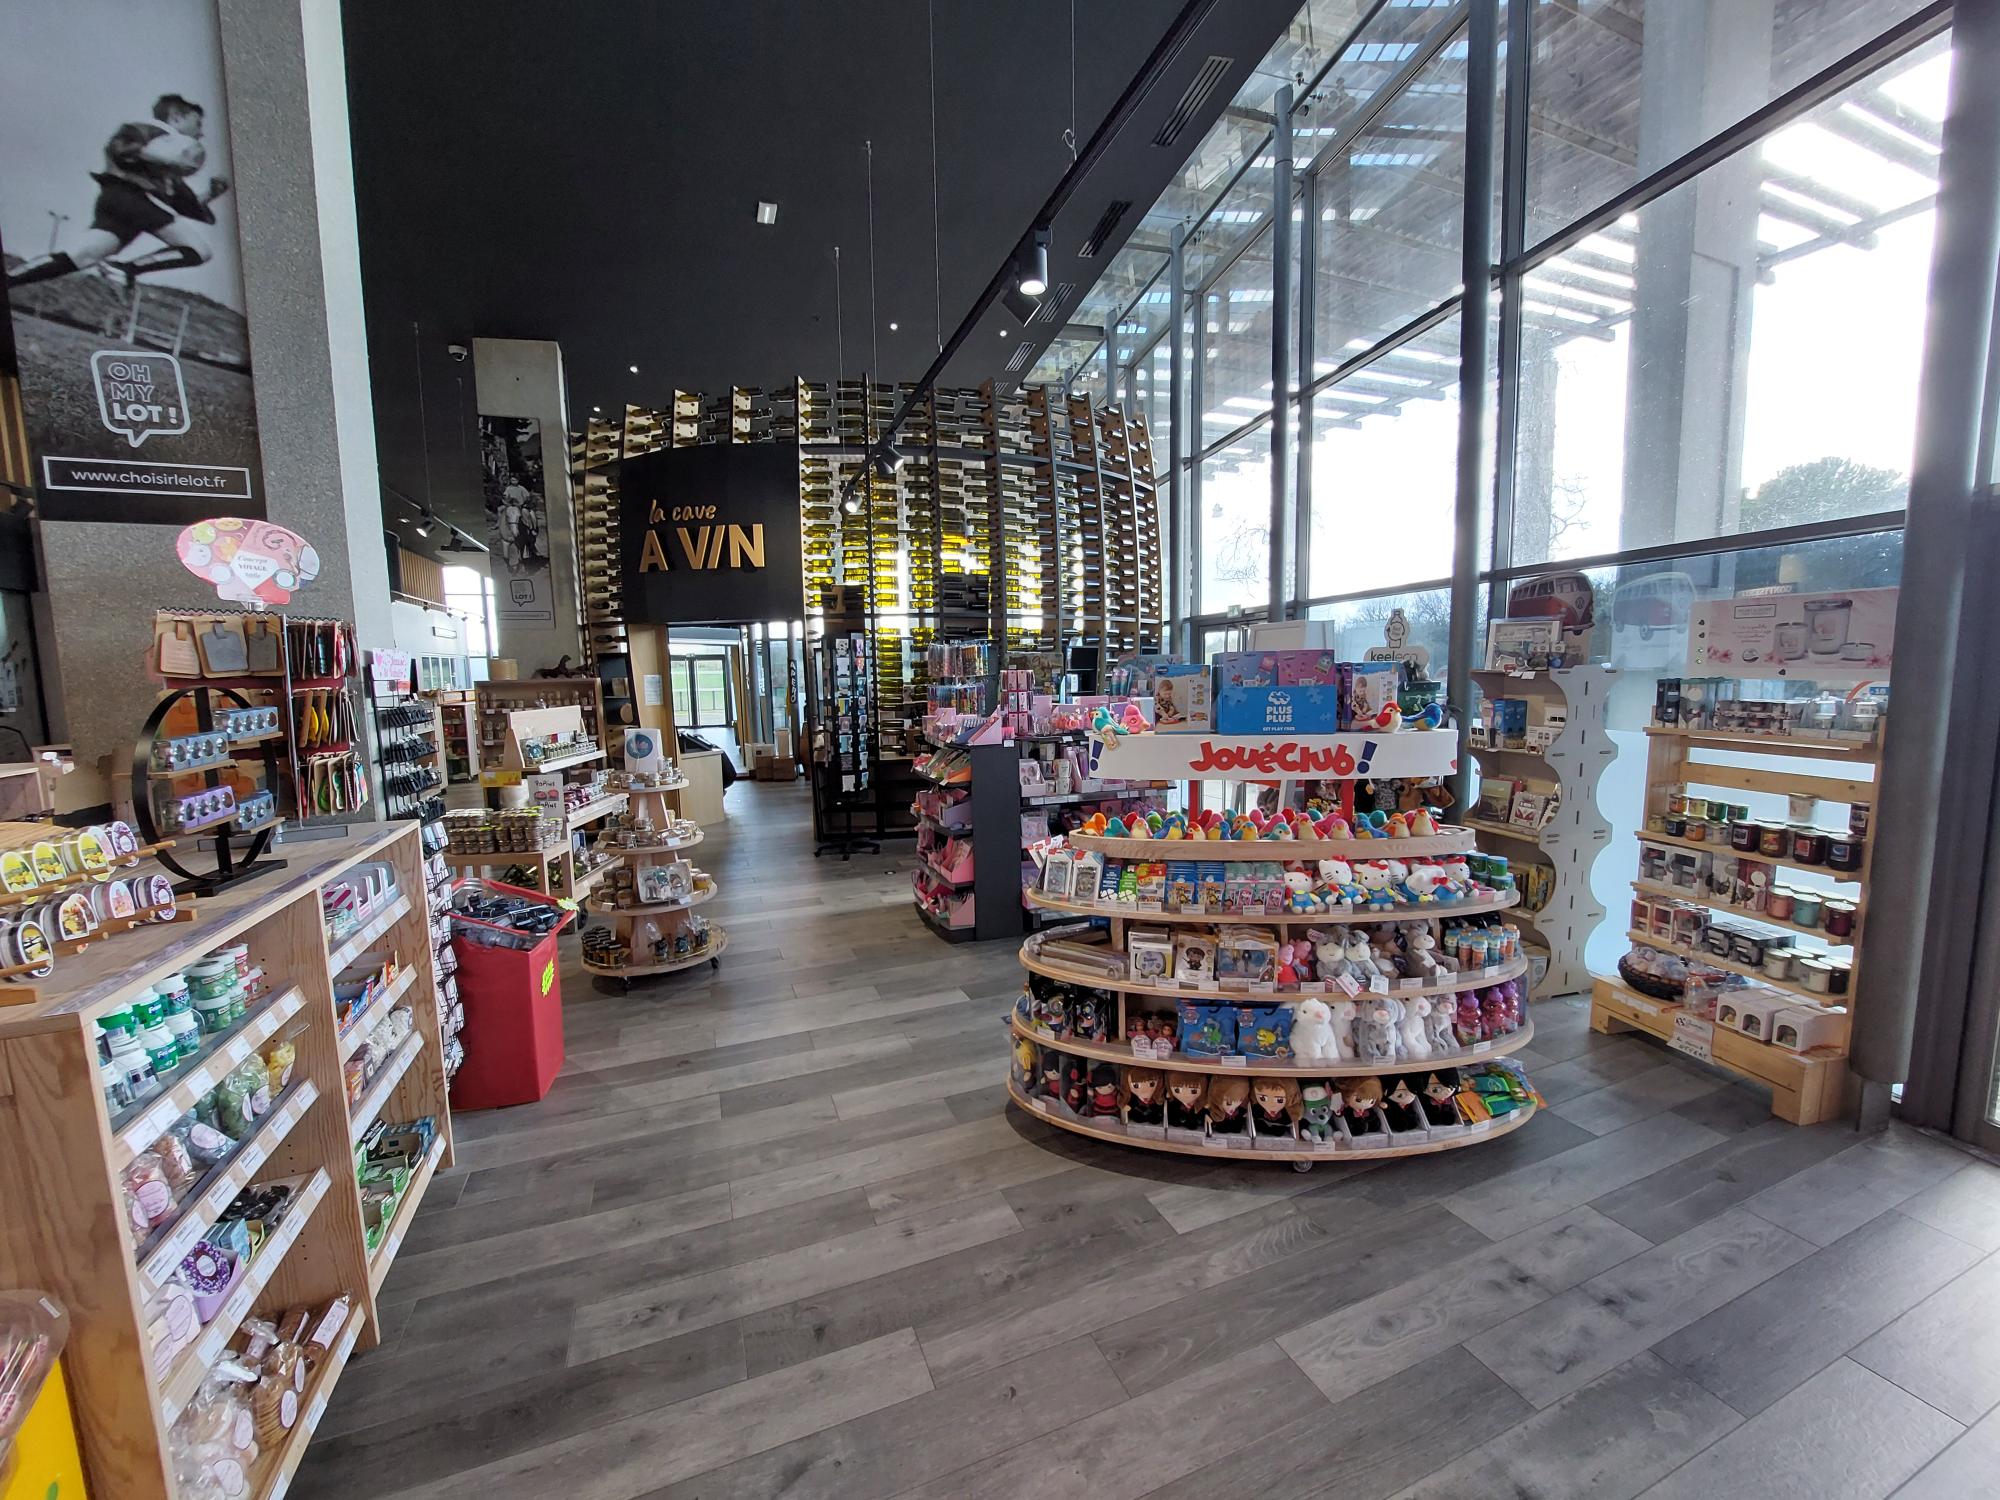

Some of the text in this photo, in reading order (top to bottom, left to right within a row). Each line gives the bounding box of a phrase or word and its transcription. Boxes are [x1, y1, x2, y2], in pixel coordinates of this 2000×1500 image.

[108, 362, 151, 383] OH
[110, 382, 155, 403] MY
[112, 402, 163, 423] LOT
[71, 470, 228, 488] www.choisirlelot.fr
[649, 499, 717, 524] la cave
[638, 523, 766, 573] A VIN
[1266, 706, 1293, 715] PLUS
[1266, 715, 1292, 723] PLUS
